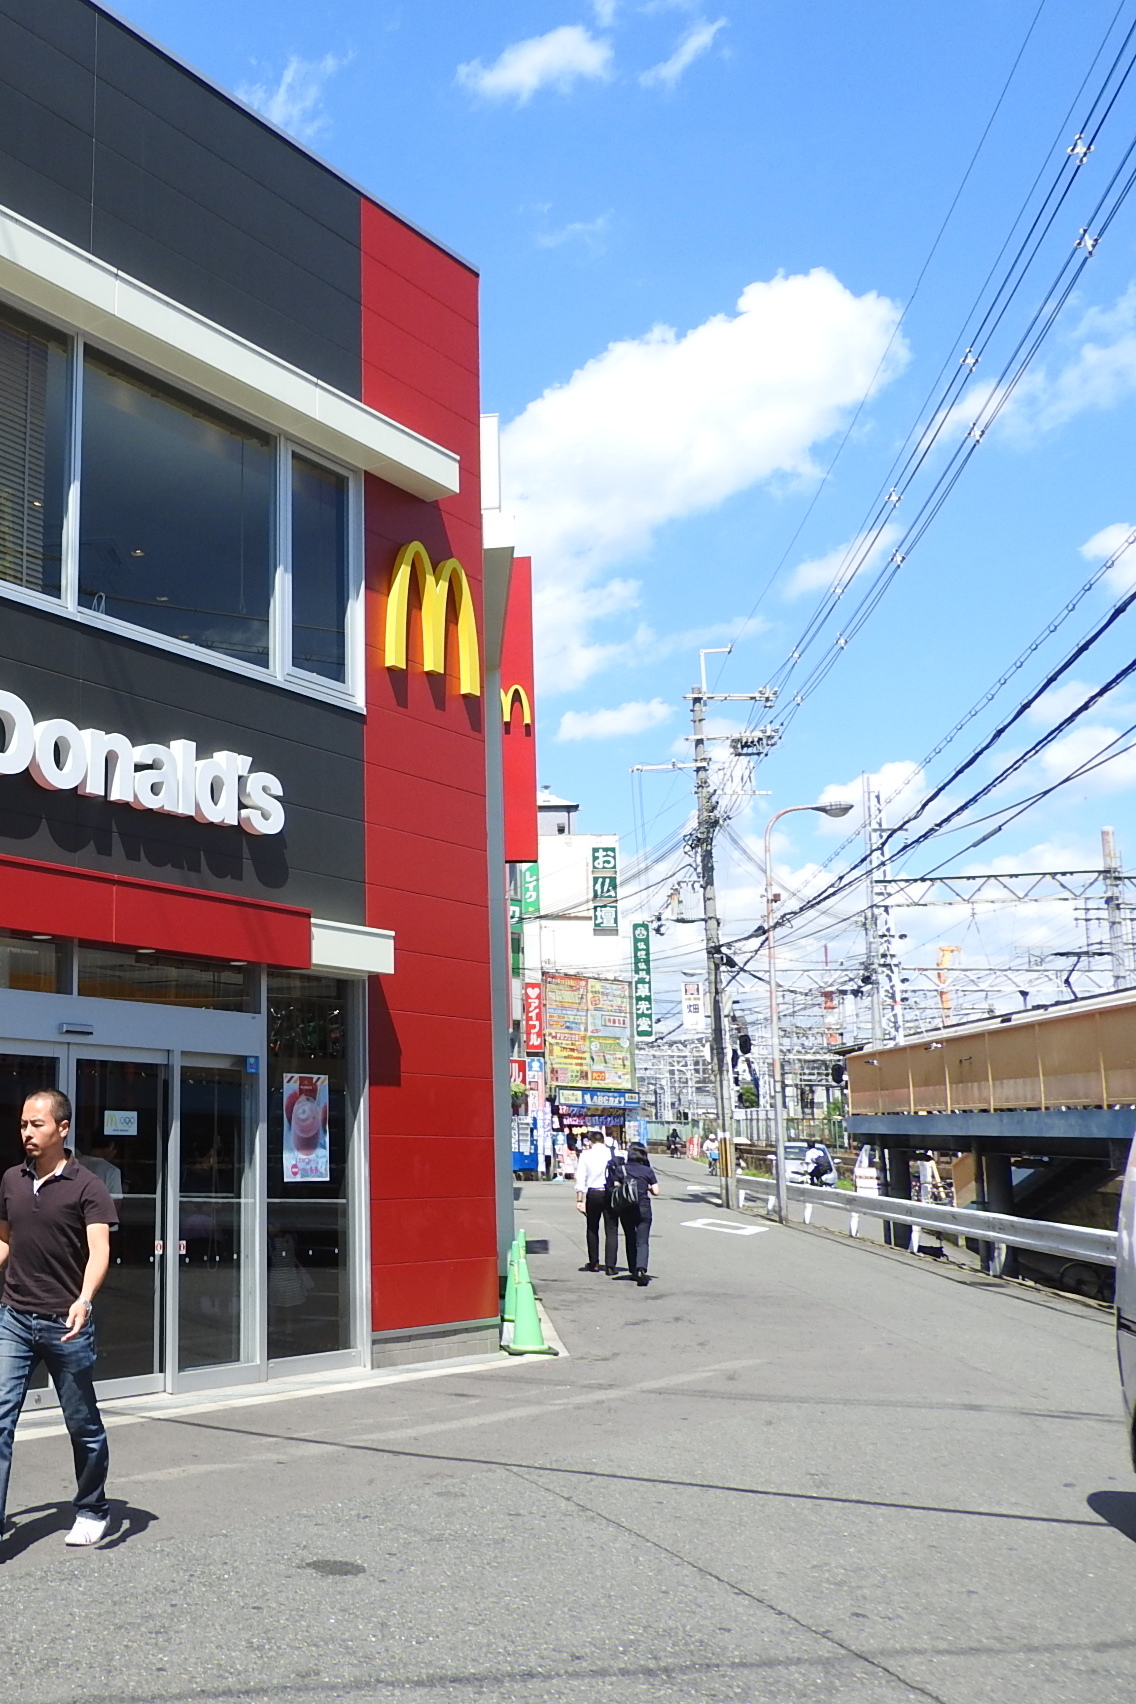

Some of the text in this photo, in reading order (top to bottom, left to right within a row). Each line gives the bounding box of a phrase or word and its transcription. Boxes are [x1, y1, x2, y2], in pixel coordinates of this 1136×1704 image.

[524, 870, 537, 903] レイク
[593, 848, 617, 928] お仏壇
[527, 998, 541, 1046] アイフル
